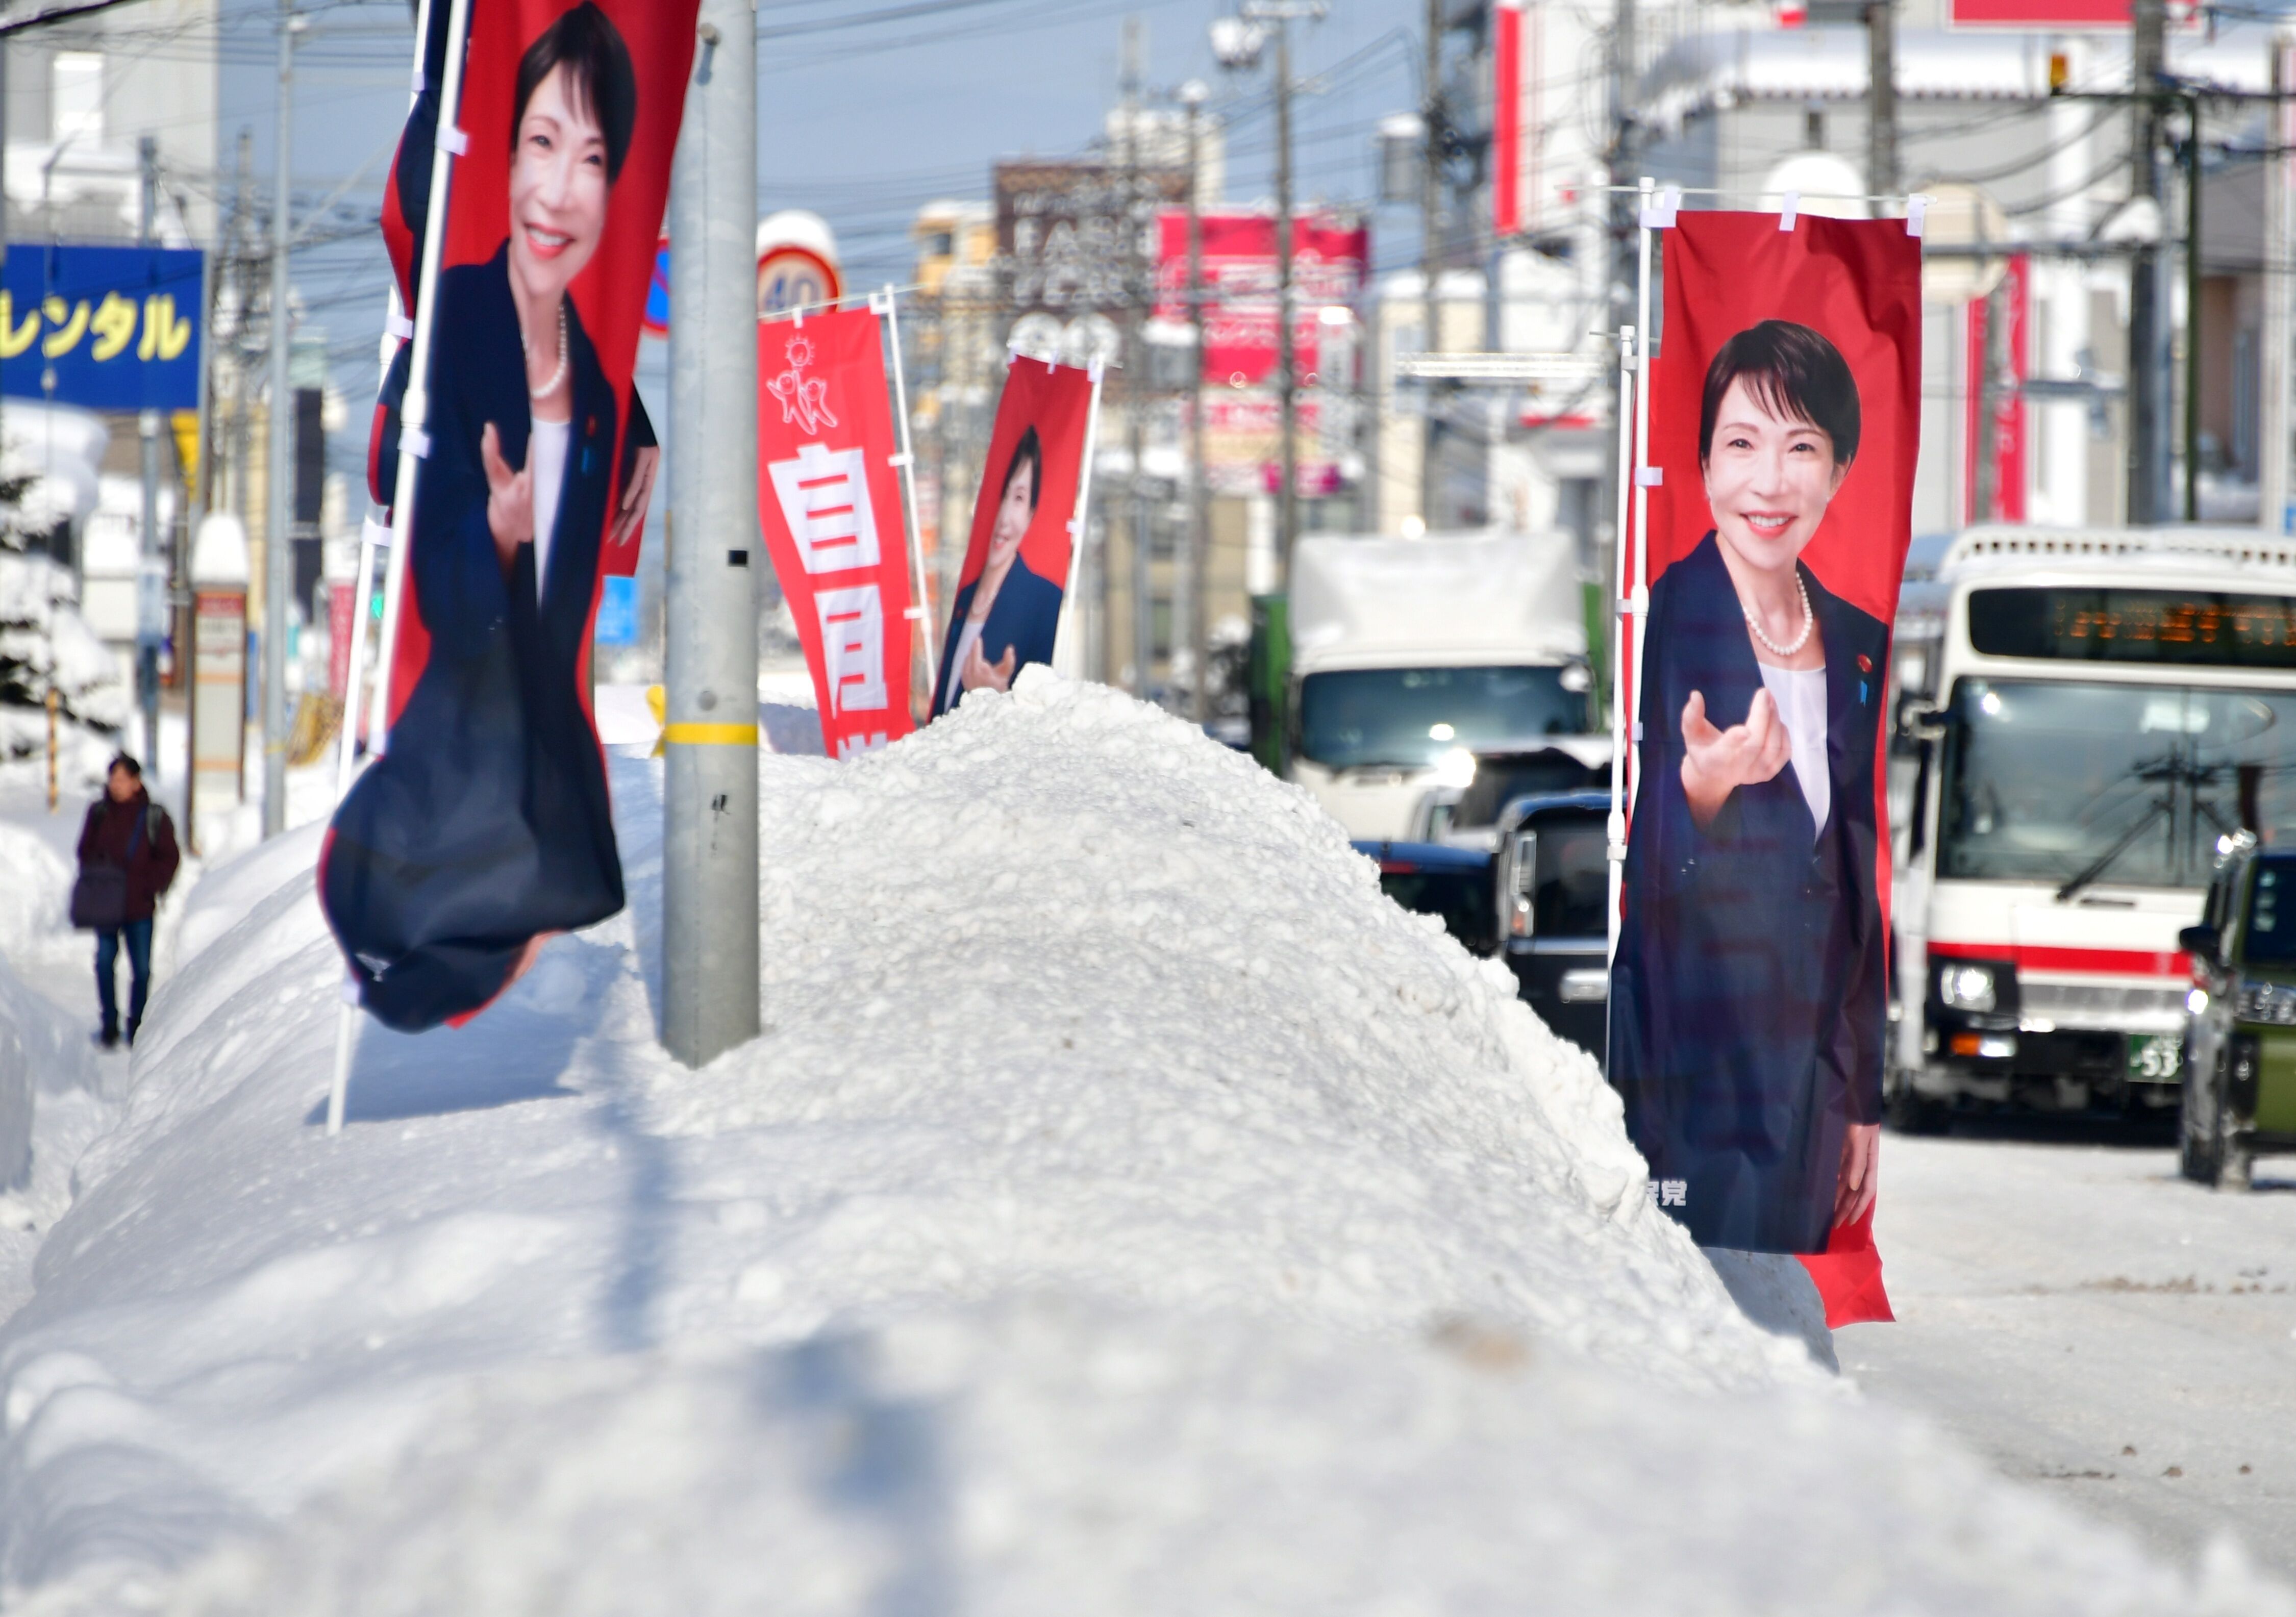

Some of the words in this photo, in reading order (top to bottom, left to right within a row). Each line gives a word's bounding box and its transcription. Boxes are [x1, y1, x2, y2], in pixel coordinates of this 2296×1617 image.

[763, 272, 820, 317] 40
[0, 288, 191, 362] レンタル
